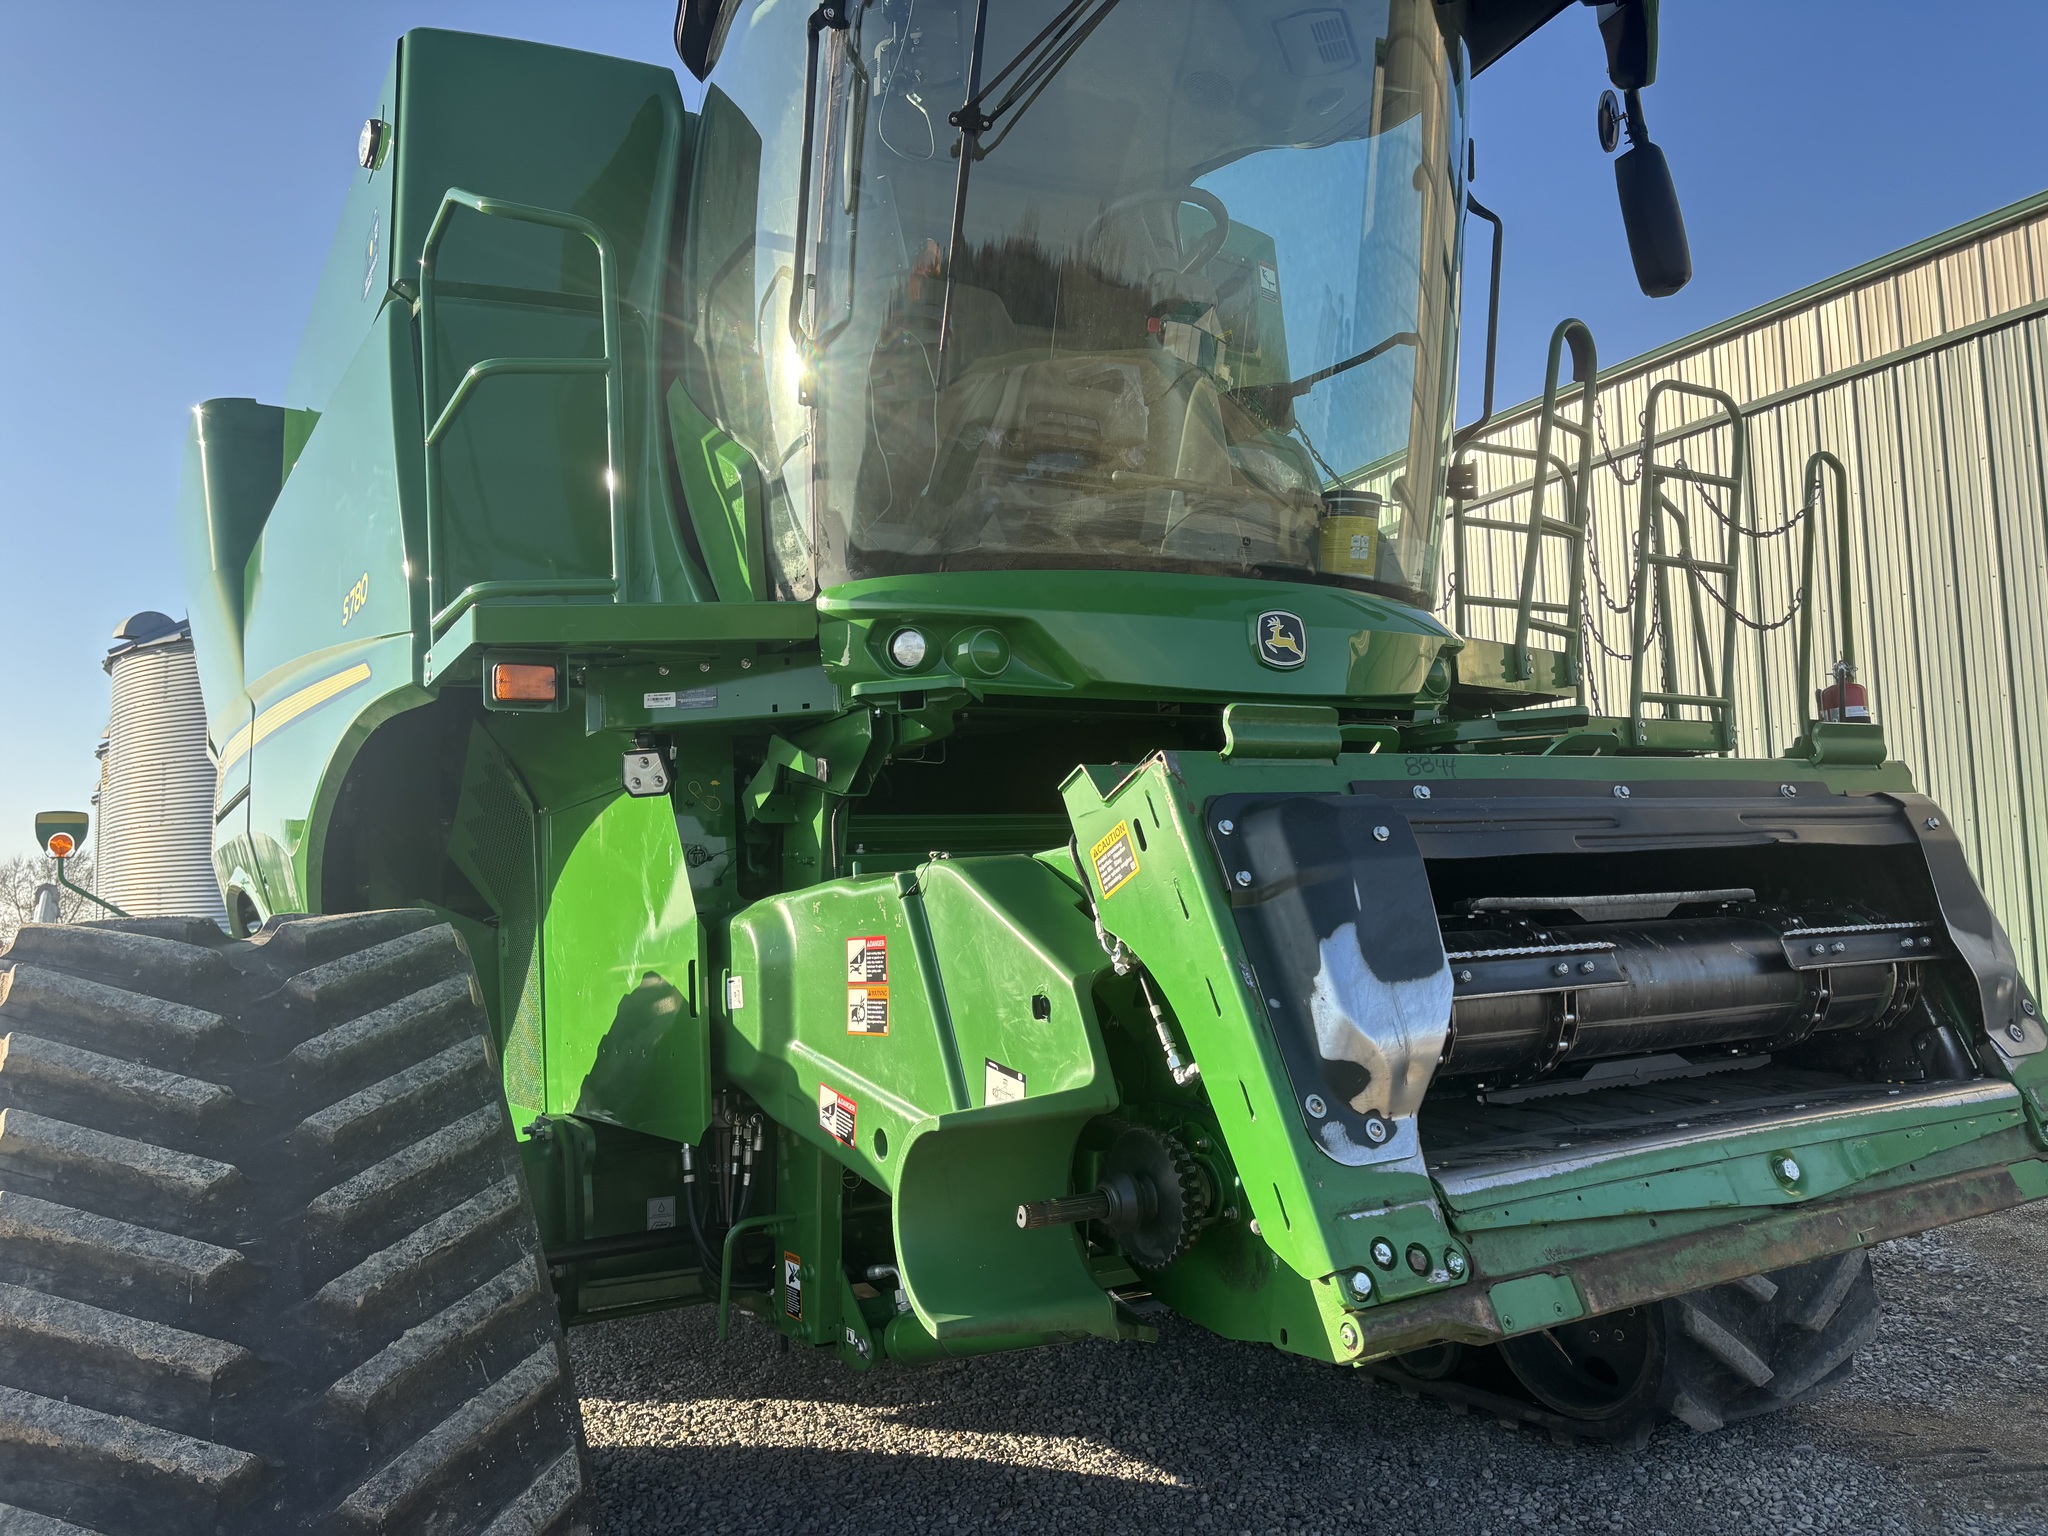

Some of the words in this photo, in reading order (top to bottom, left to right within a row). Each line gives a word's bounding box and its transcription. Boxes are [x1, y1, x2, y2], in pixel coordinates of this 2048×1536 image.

[342, 571, 369, 627] S780
[1404, 756, 1457, 778] 8844
[1097, 823, 1126, 853] CAUTION
